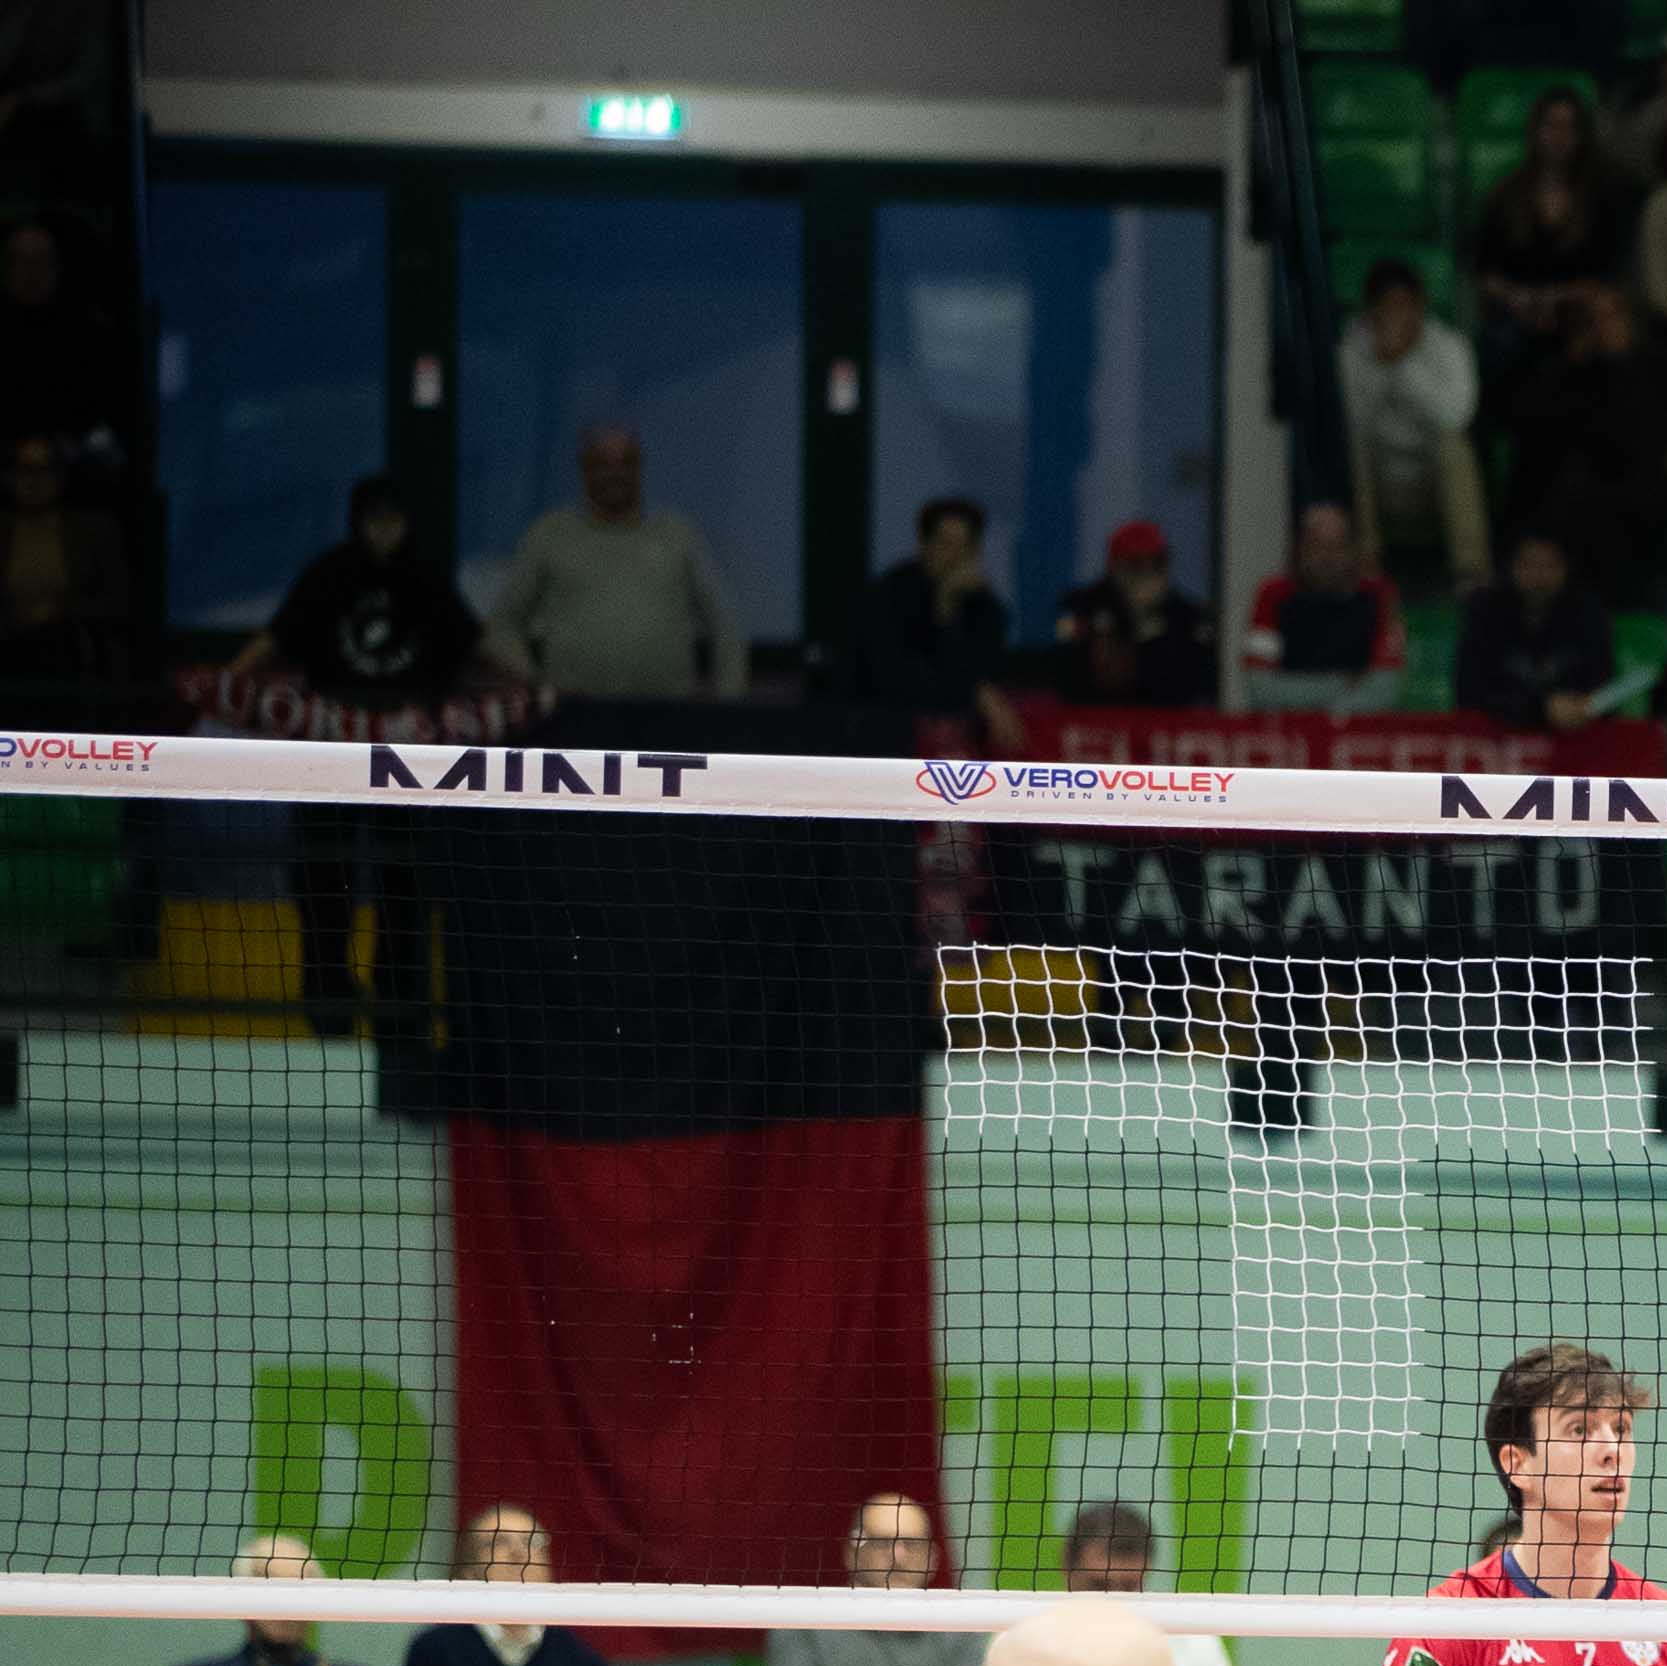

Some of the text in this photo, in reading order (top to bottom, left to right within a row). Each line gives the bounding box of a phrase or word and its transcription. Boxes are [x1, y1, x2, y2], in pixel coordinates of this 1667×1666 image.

[26, 761, 149, 771] BY VALUES
[370, 745, 707, 797] MINT
[1003, 767, 1235, 793] VEROVOLLEY
[1011, 791, 1227, 803] DRIVEN BY VALUES
[1031, 838, 1600, 940] TARANTO
